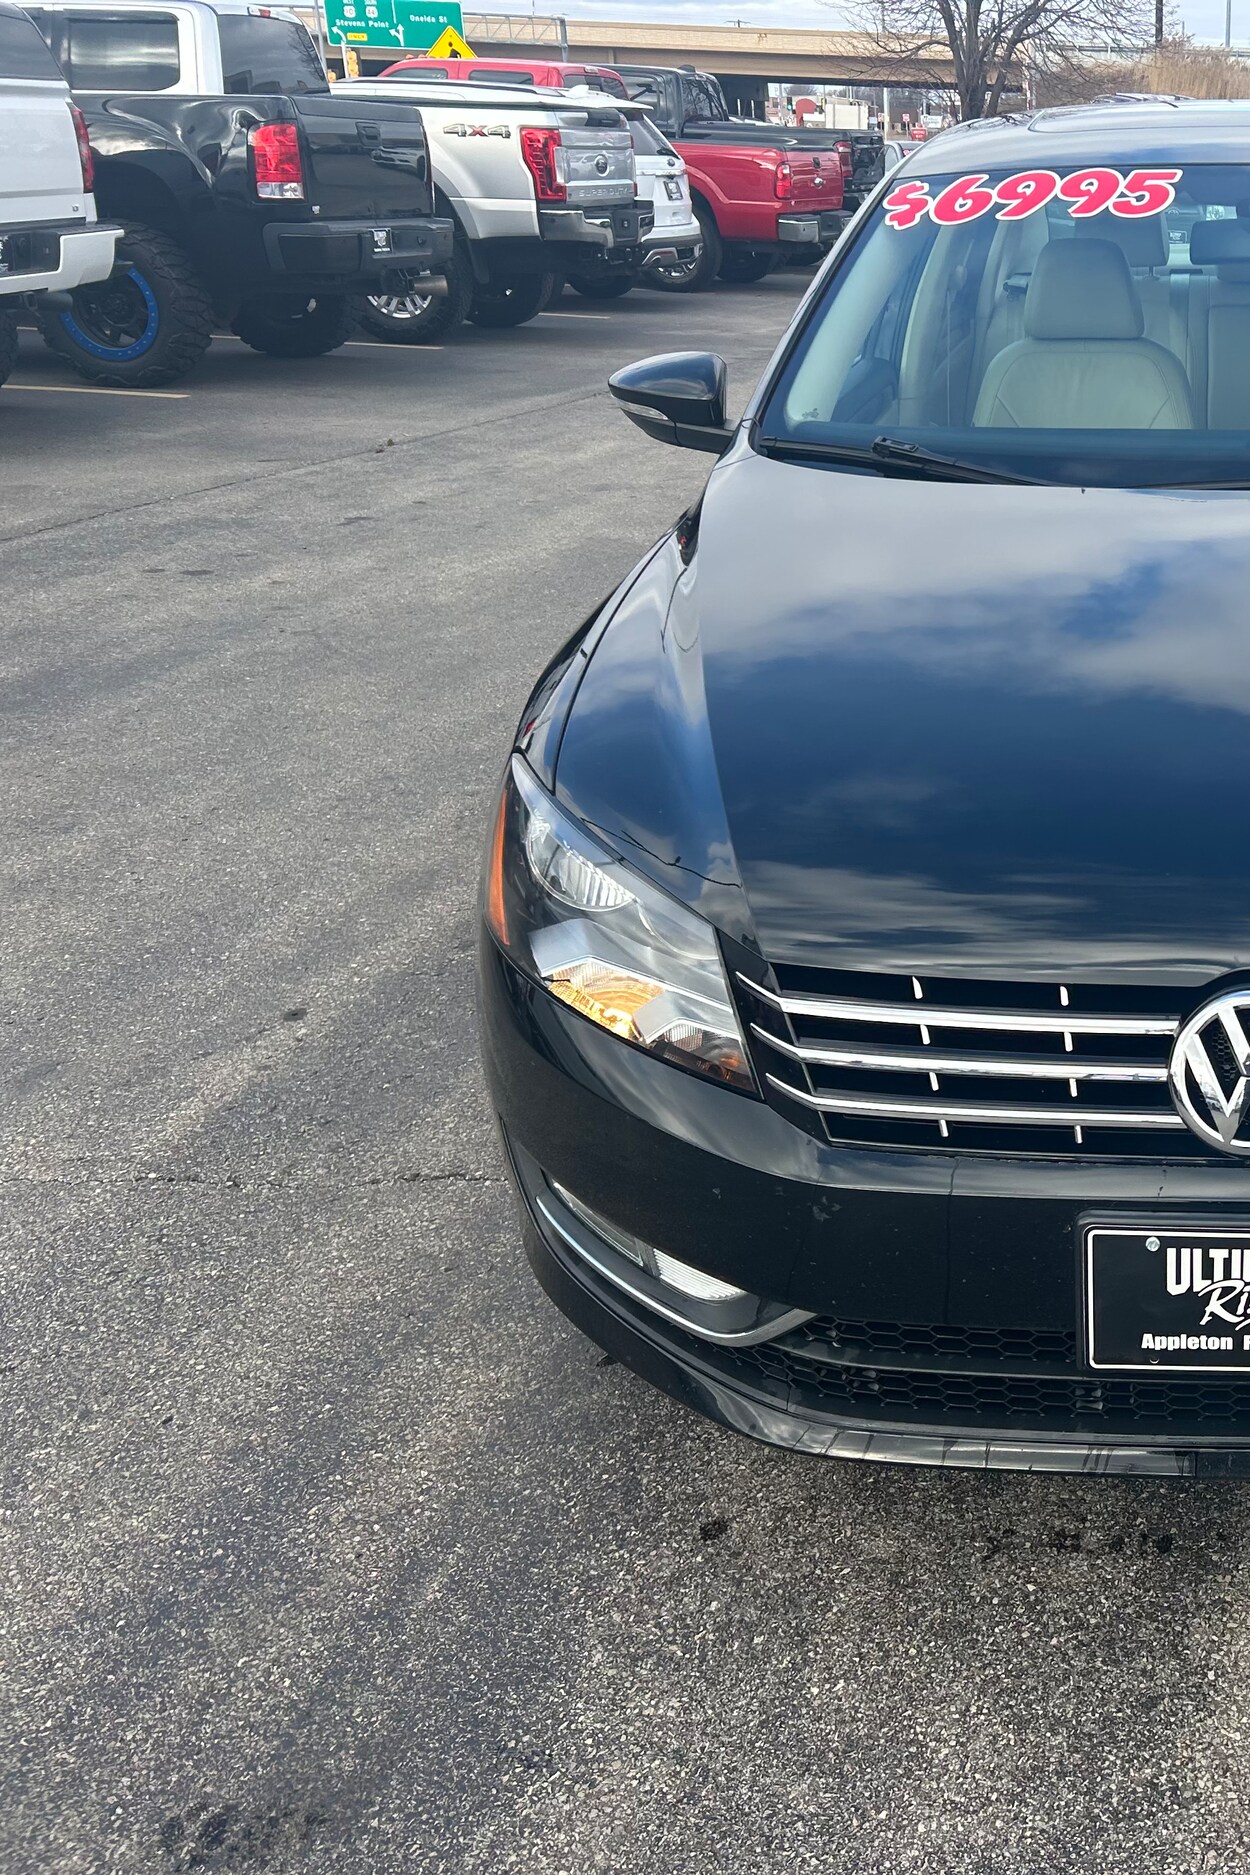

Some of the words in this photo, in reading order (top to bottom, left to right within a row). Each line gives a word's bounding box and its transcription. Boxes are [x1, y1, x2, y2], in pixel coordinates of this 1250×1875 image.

[368, 20, 389, 28] Point
[410, 14, 436, 22] Oneida
[438, 15, 448, 23] St
[882, 168, 1184, 230] $6995
[1141, 1333, 1233, 1351] Appleton
